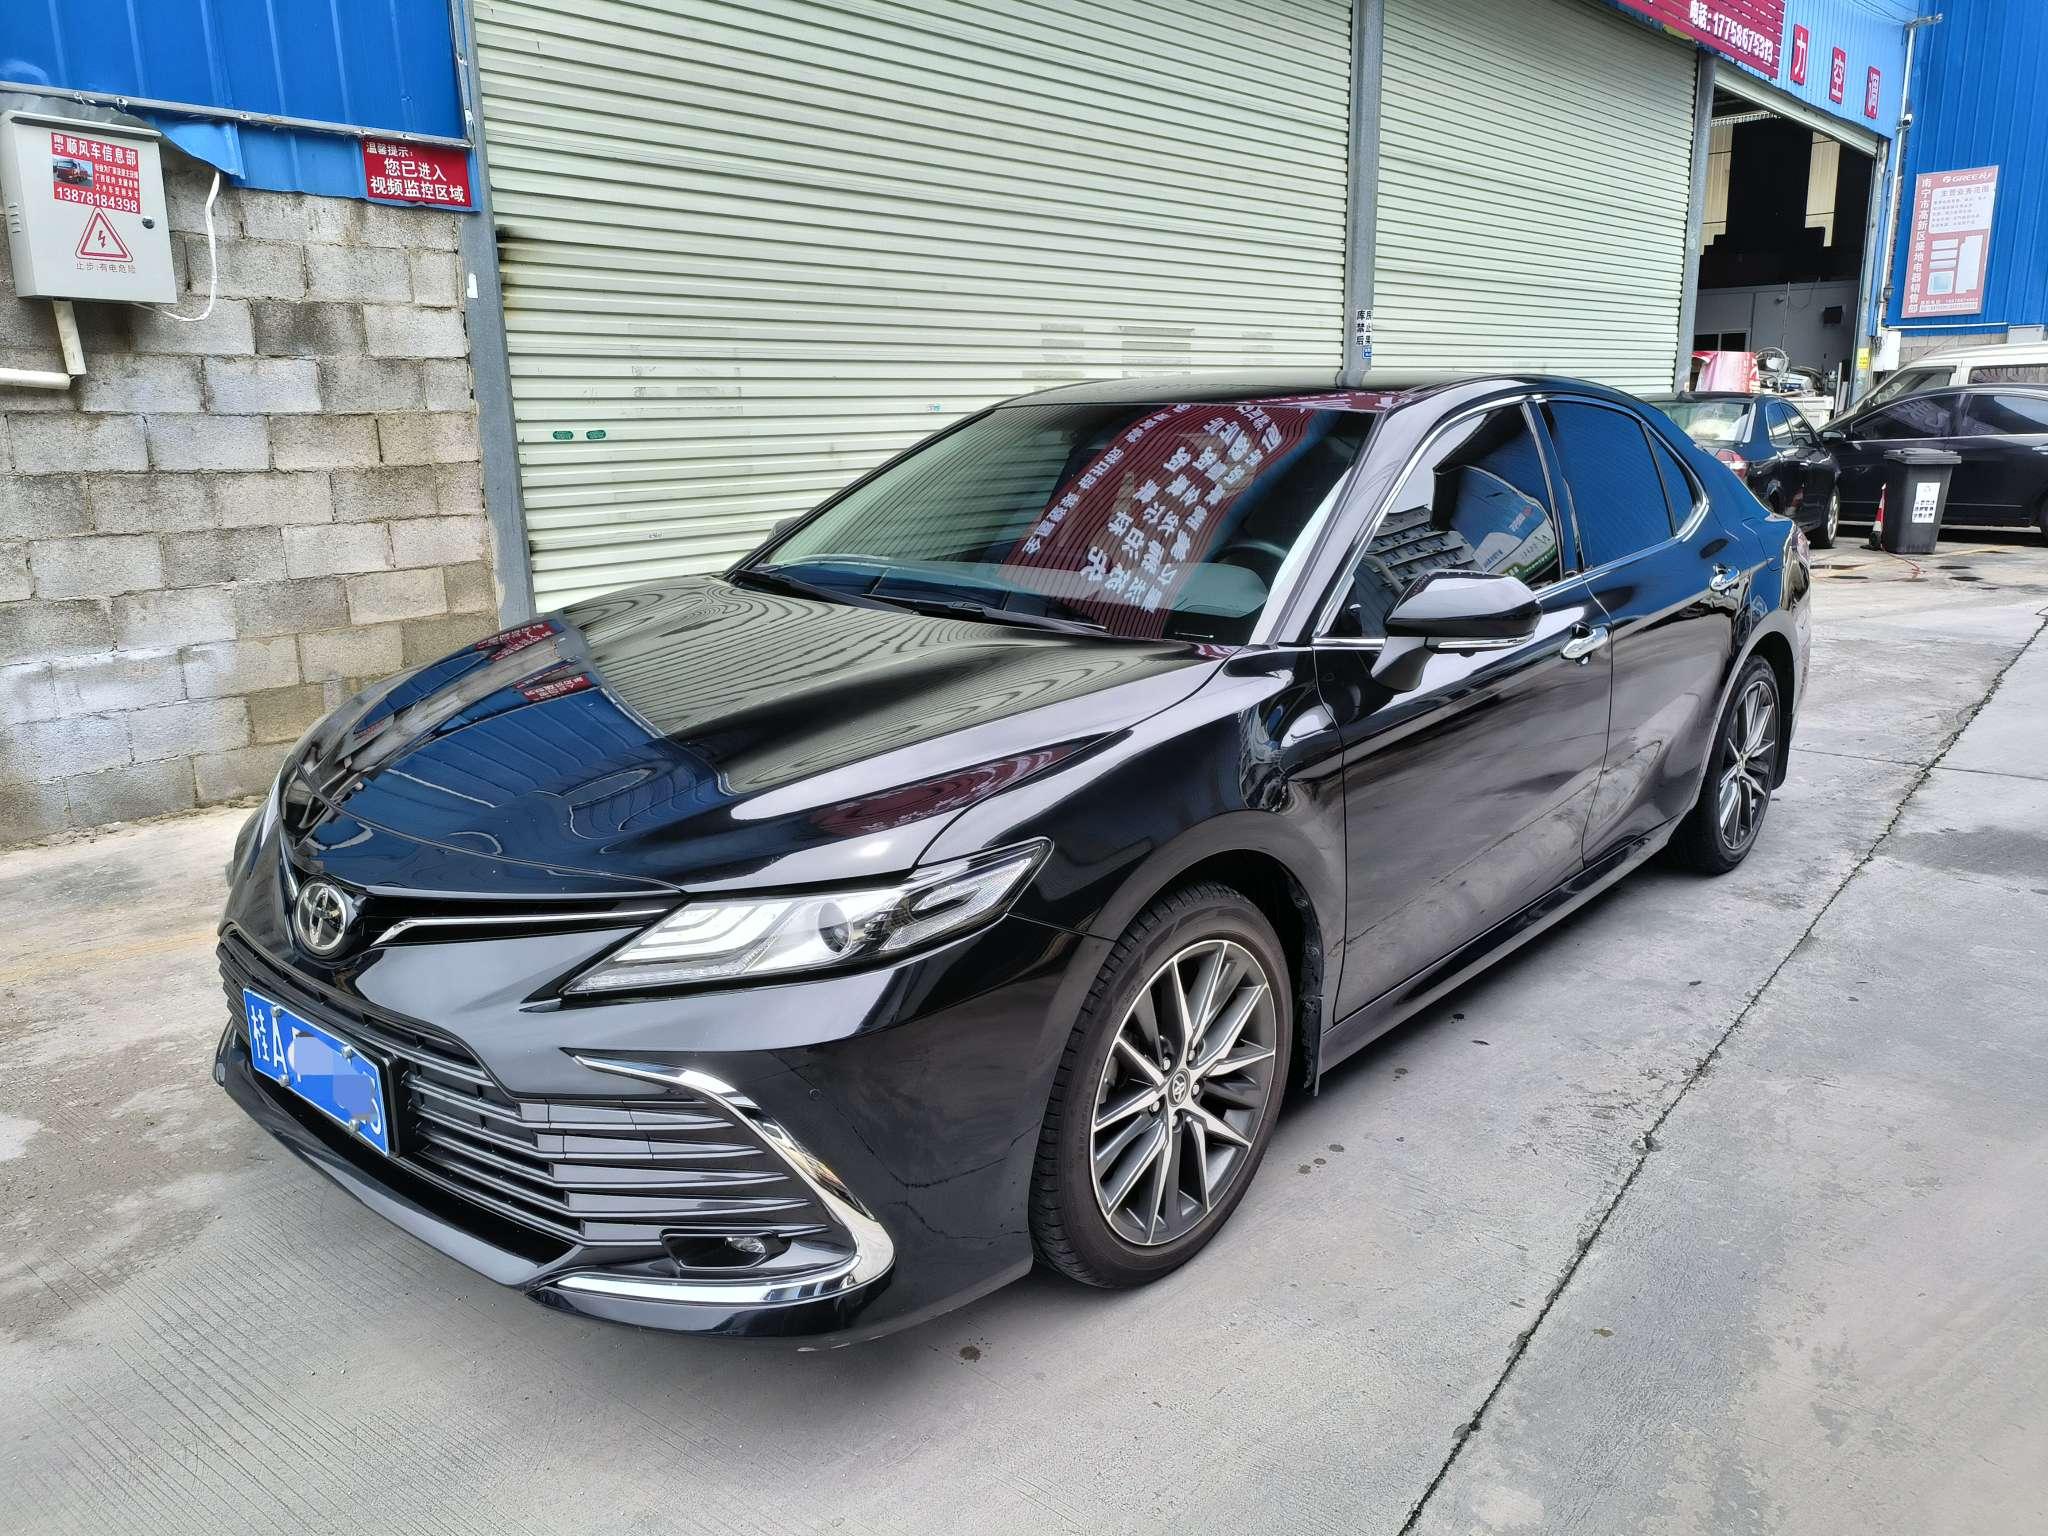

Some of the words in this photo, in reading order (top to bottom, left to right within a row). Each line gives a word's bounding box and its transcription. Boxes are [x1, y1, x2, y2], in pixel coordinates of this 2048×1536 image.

[384, 158, 447, 181] 您已进入
[57, 187, 138, 212] 13878184398
[370, 176, 465, 202] 视频监控区域
